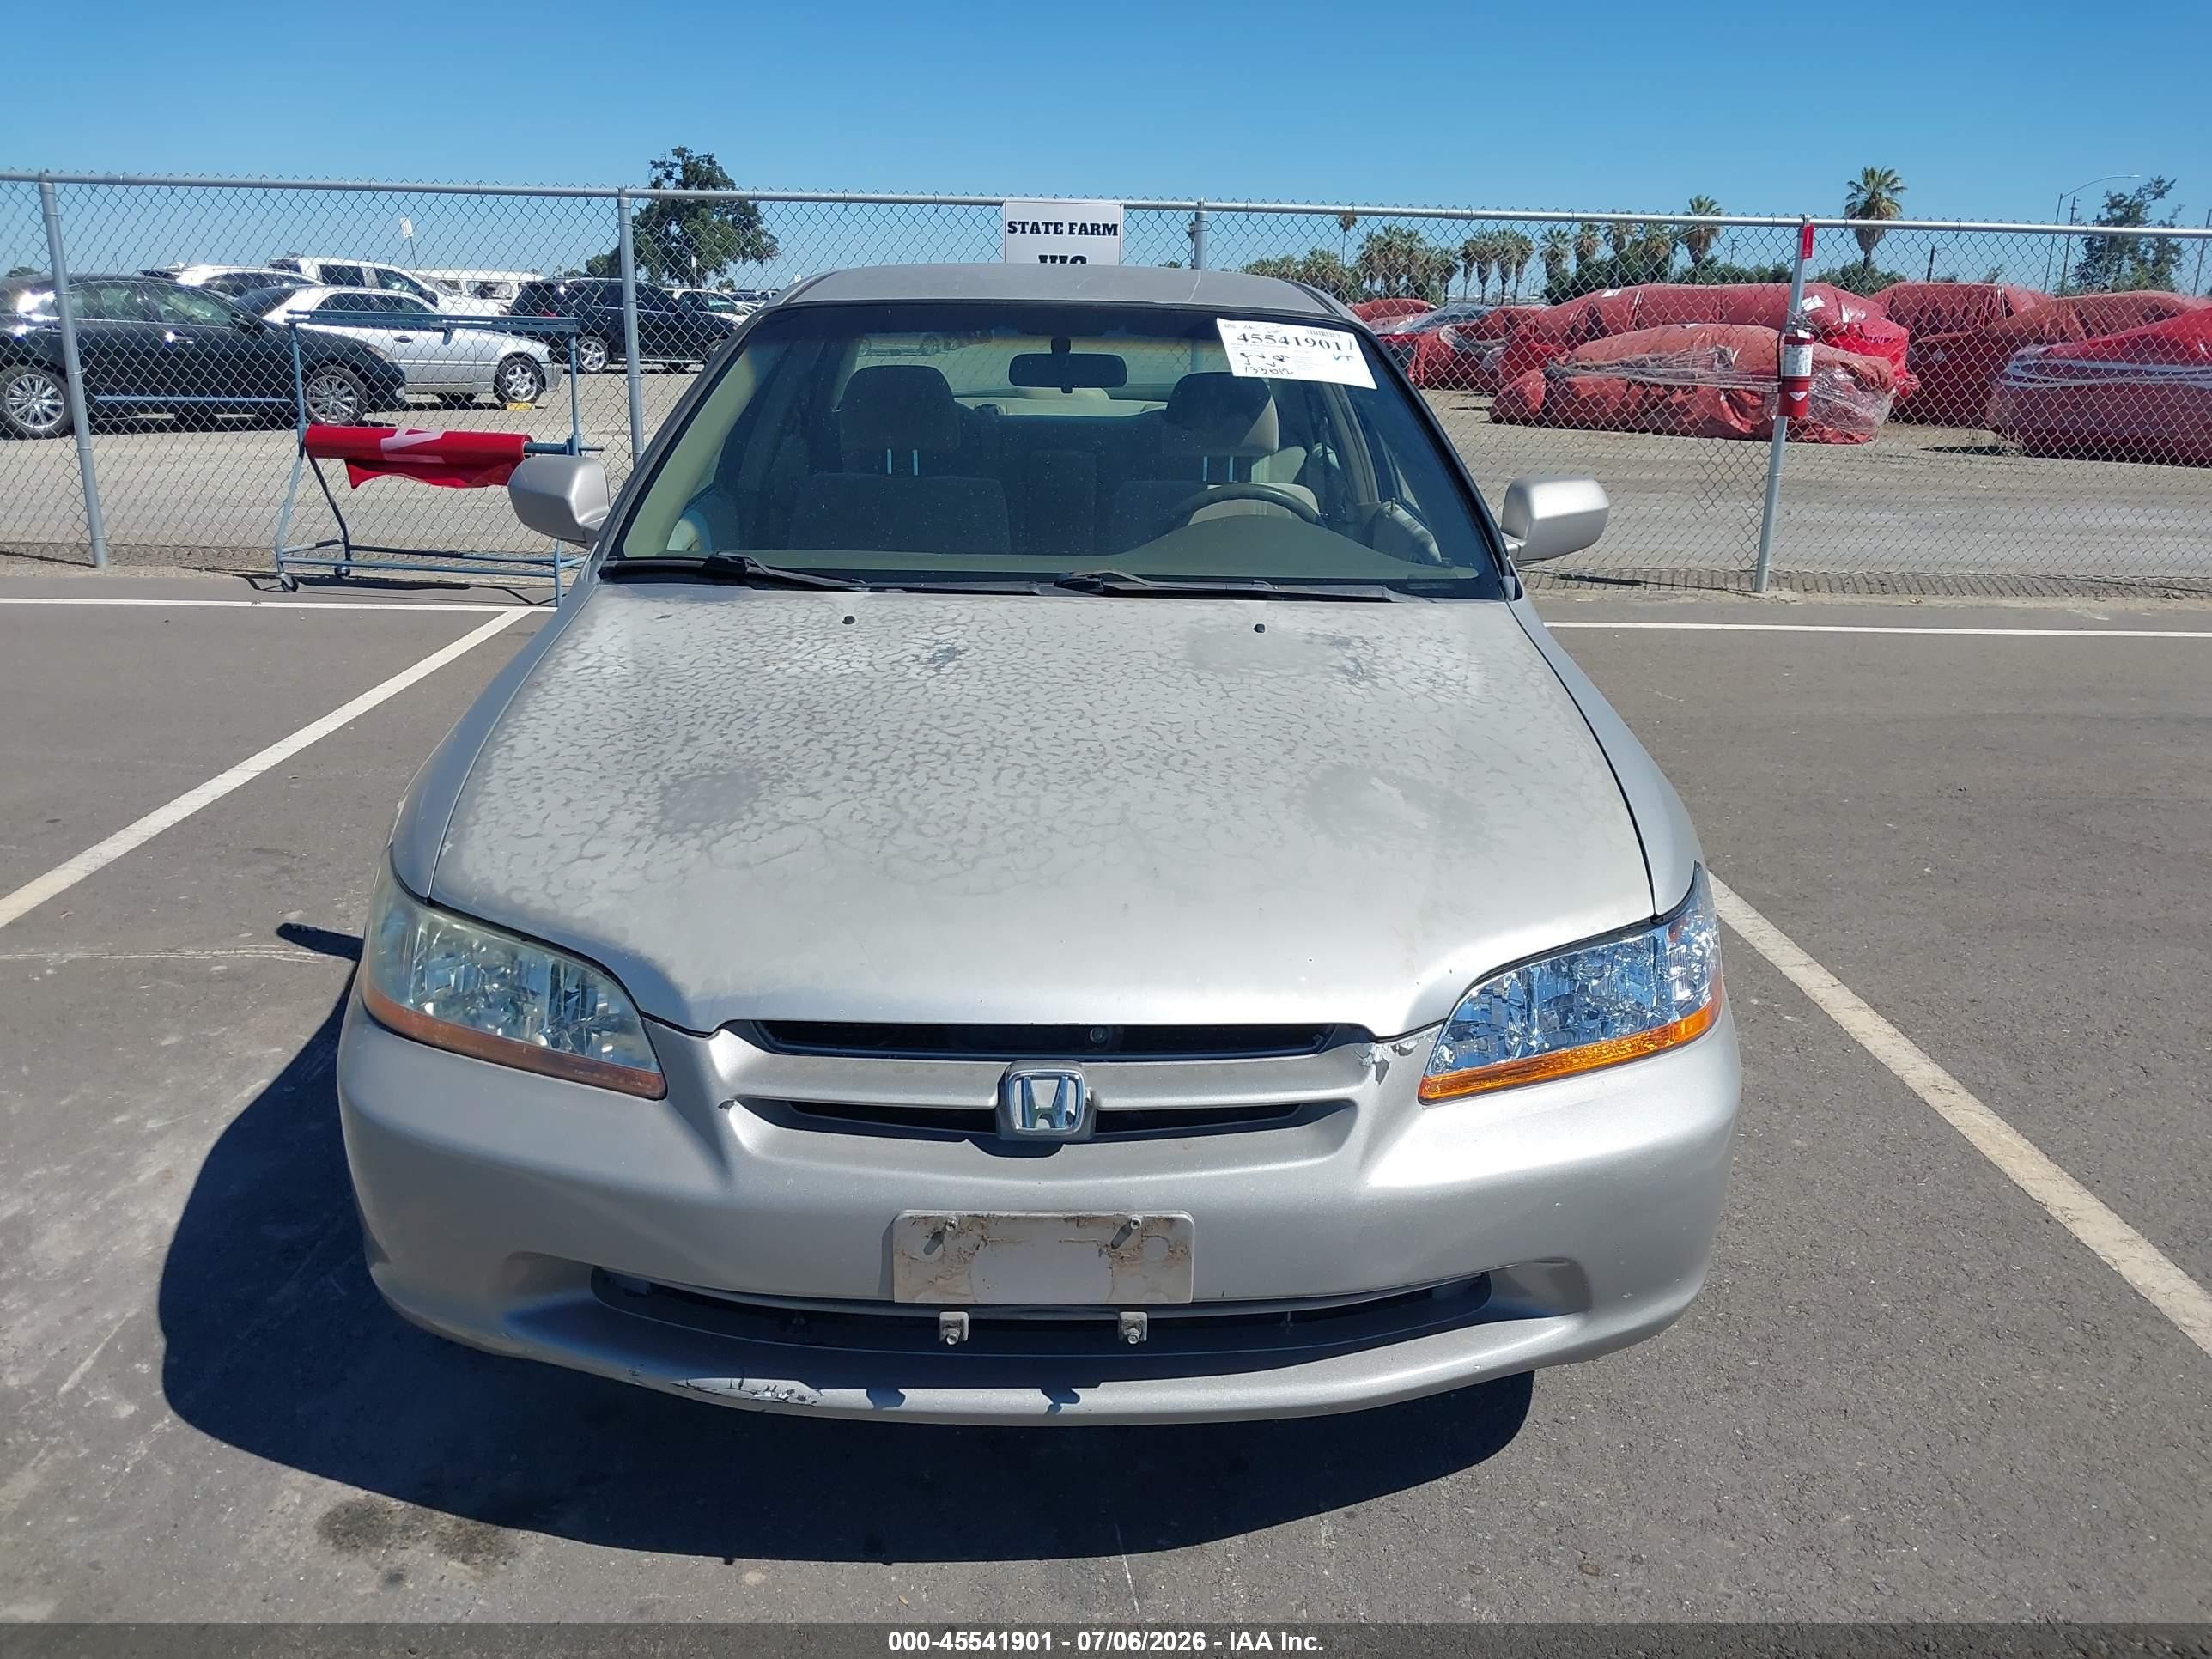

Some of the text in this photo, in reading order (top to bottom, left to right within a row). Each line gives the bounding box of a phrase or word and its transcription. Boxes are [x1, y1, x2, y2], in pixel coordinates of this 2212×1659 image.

[1007, 220, 1119, 236] STATE FARM
[1237, 332, 1343, 351] 45541901
